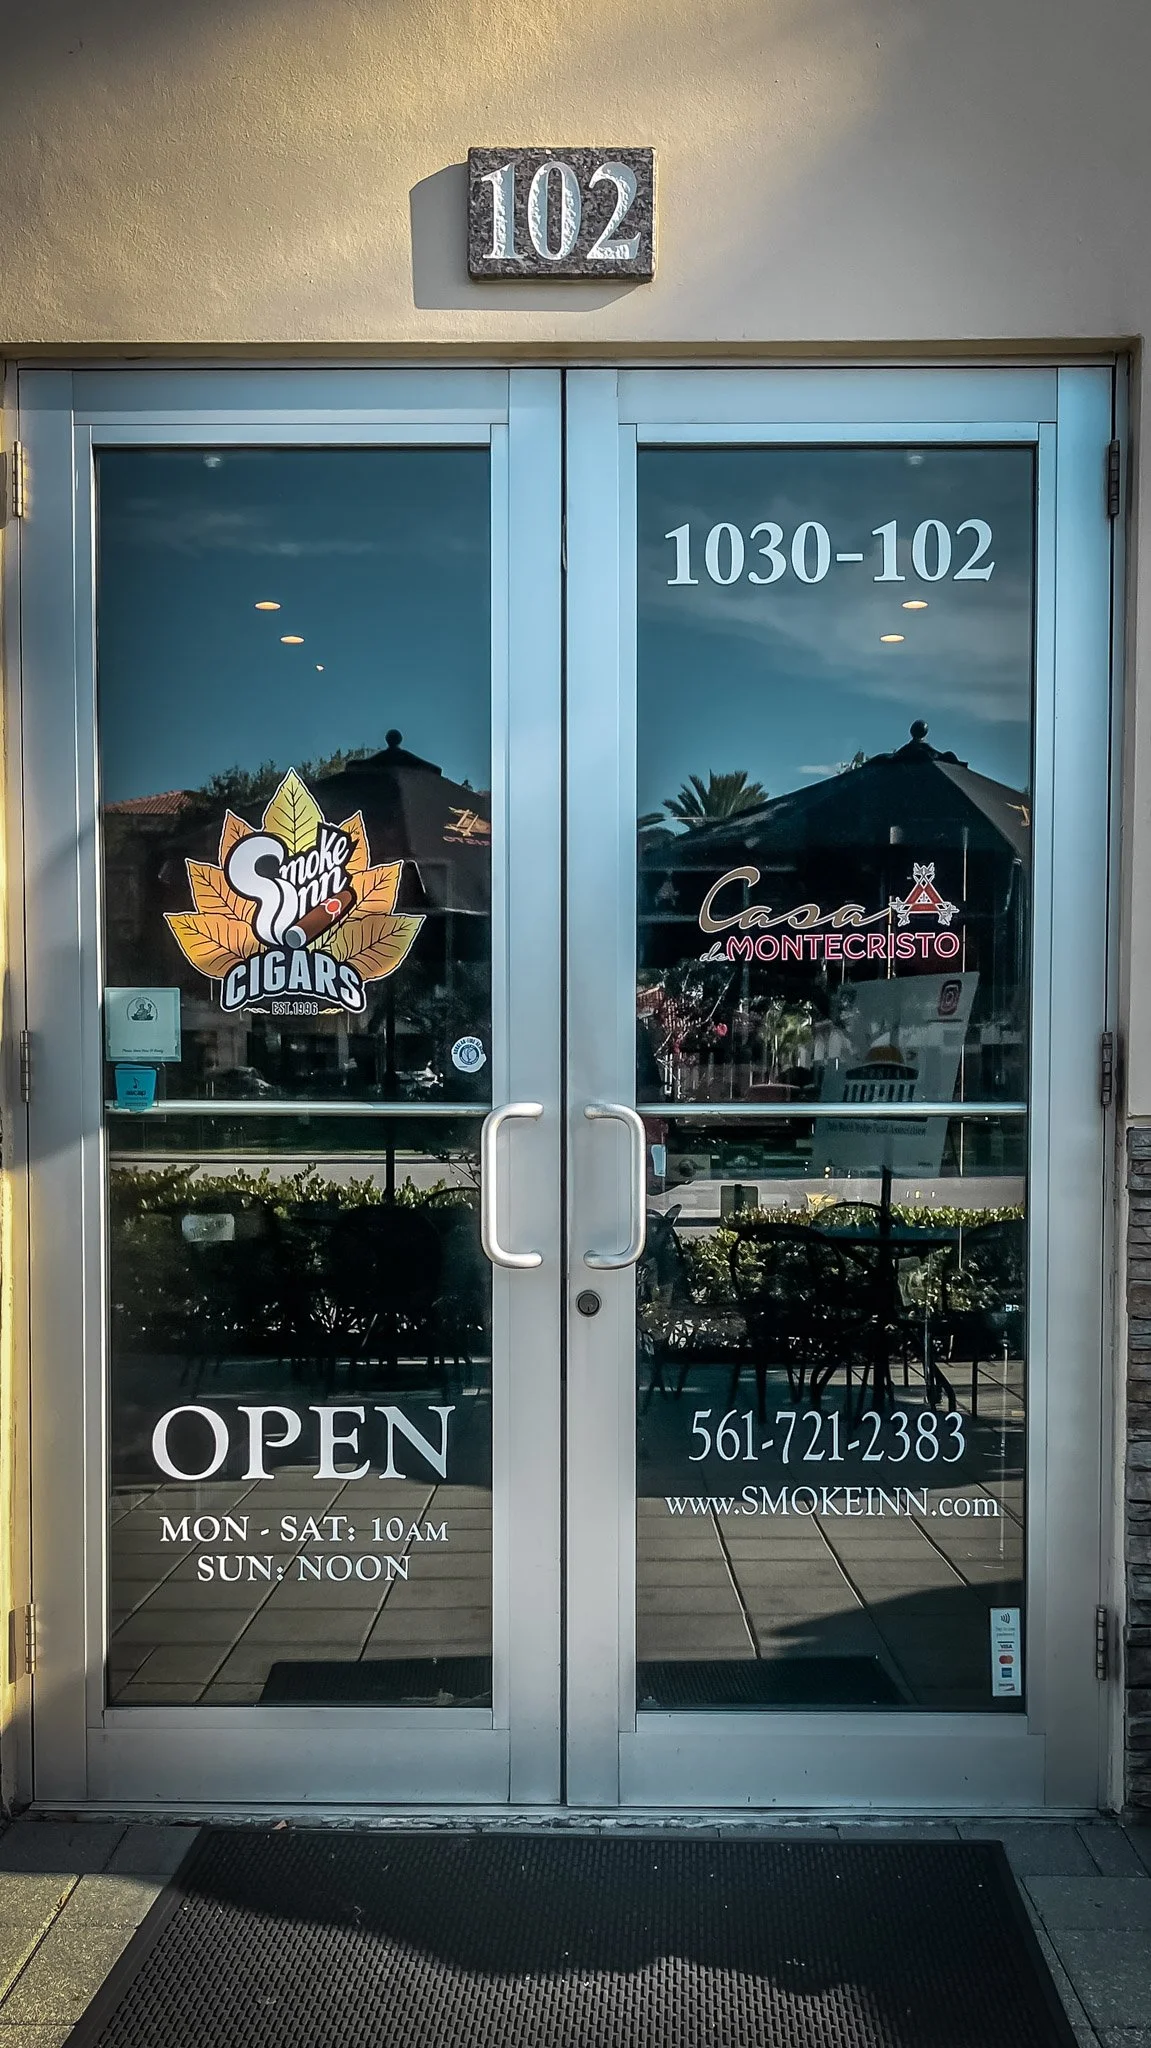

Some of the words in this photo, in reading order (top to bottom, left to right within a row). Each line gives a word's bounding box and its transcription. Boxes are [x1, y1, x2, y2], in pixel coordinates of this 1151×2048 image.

[481, 161, 642, 260] 102
[665, 519, 996, 585] 1030-102
[229, 828, 350, 946] Smoke
[699, 866, 892, 934] Casa
[726, 932, 960, 962] MONTECRISTO
[225, 950, 362, 1008] CIGARS
[152, 1405, 456, 1481] OPEN
[688, 1408, 966, 1464] 561-721-2383
[159, 1516, 249, 1542] MON
[279, 1515, 356, 1542] SAT:
[371, 1517, 450, 1542] 10AM
[665, 1485, 1000, 1518] www.SMOKEINN.com
[197, 1555, 285, 1582] SUN:
[296, 1555, 412, 1582] NOON
